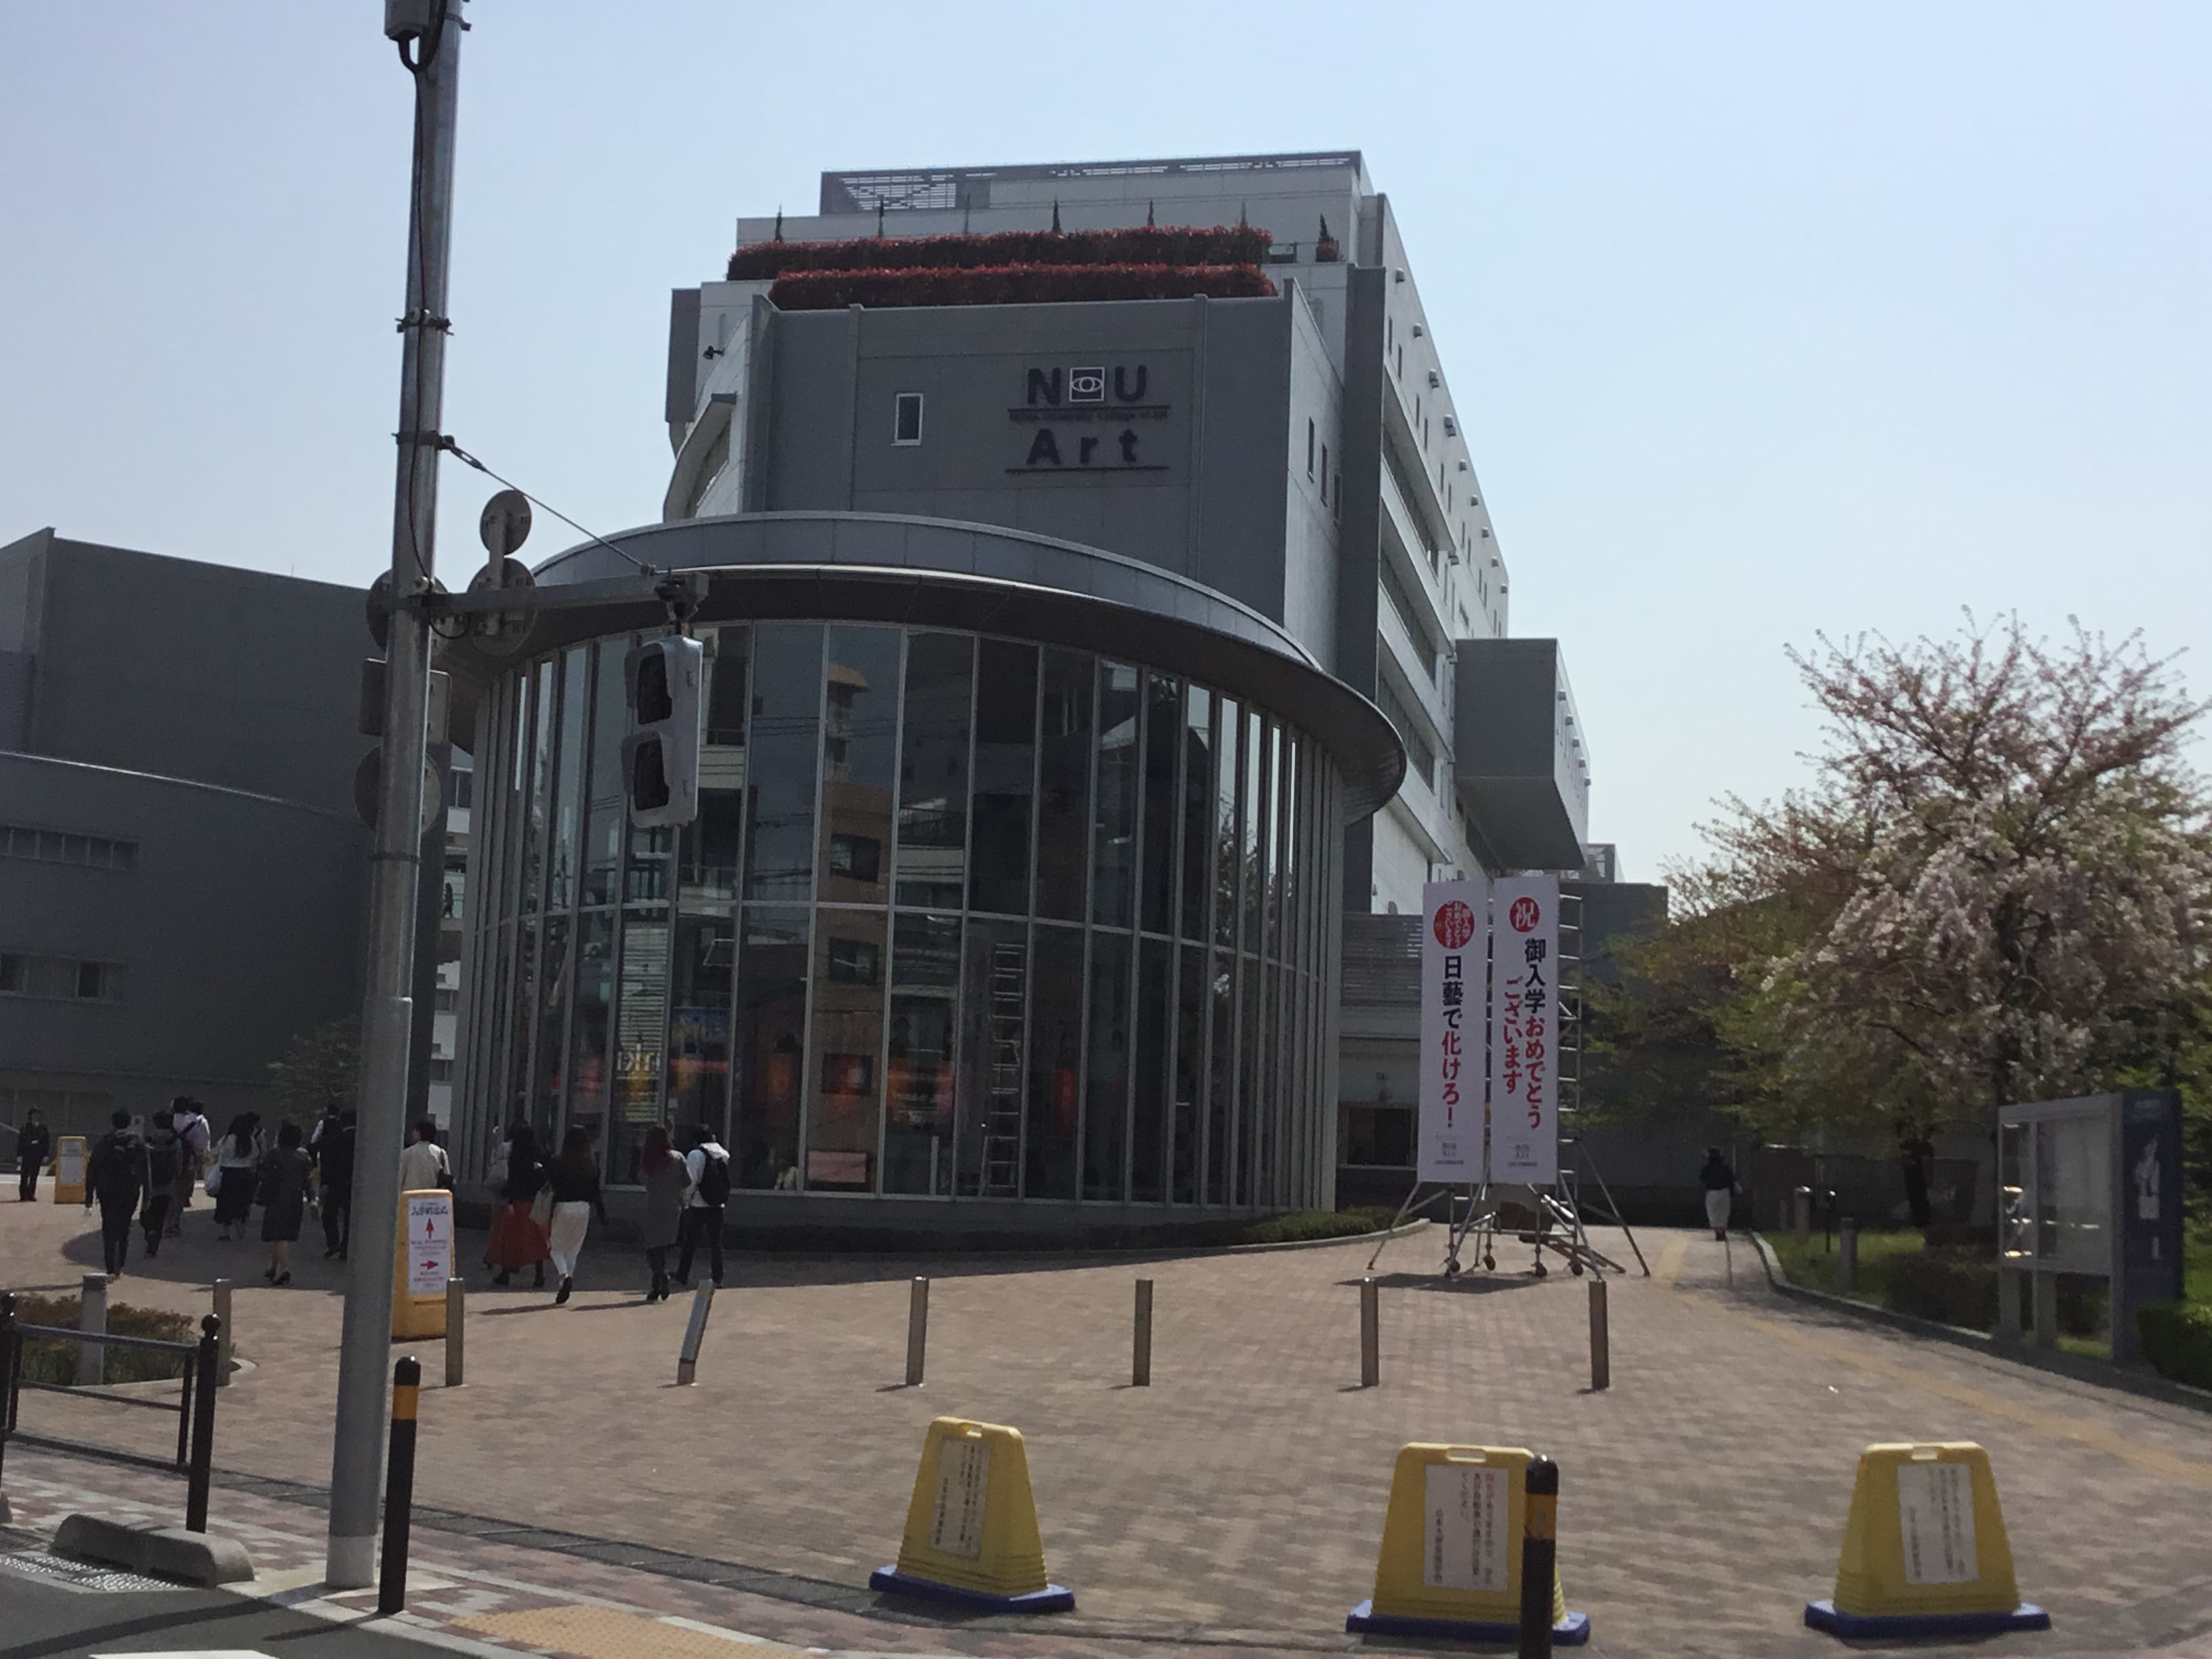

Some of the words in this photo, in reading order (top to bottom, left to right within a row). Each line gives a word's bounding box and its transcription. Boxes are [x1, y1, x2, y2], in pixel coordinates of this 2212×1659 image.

[1025, 428, 1139, 466] Art
[1515, 901, 1535, 928] 祝
[1502, 975, 1523, 1094] ございます
[1524, 937, 1547, 1129] 御入学おめでとう
